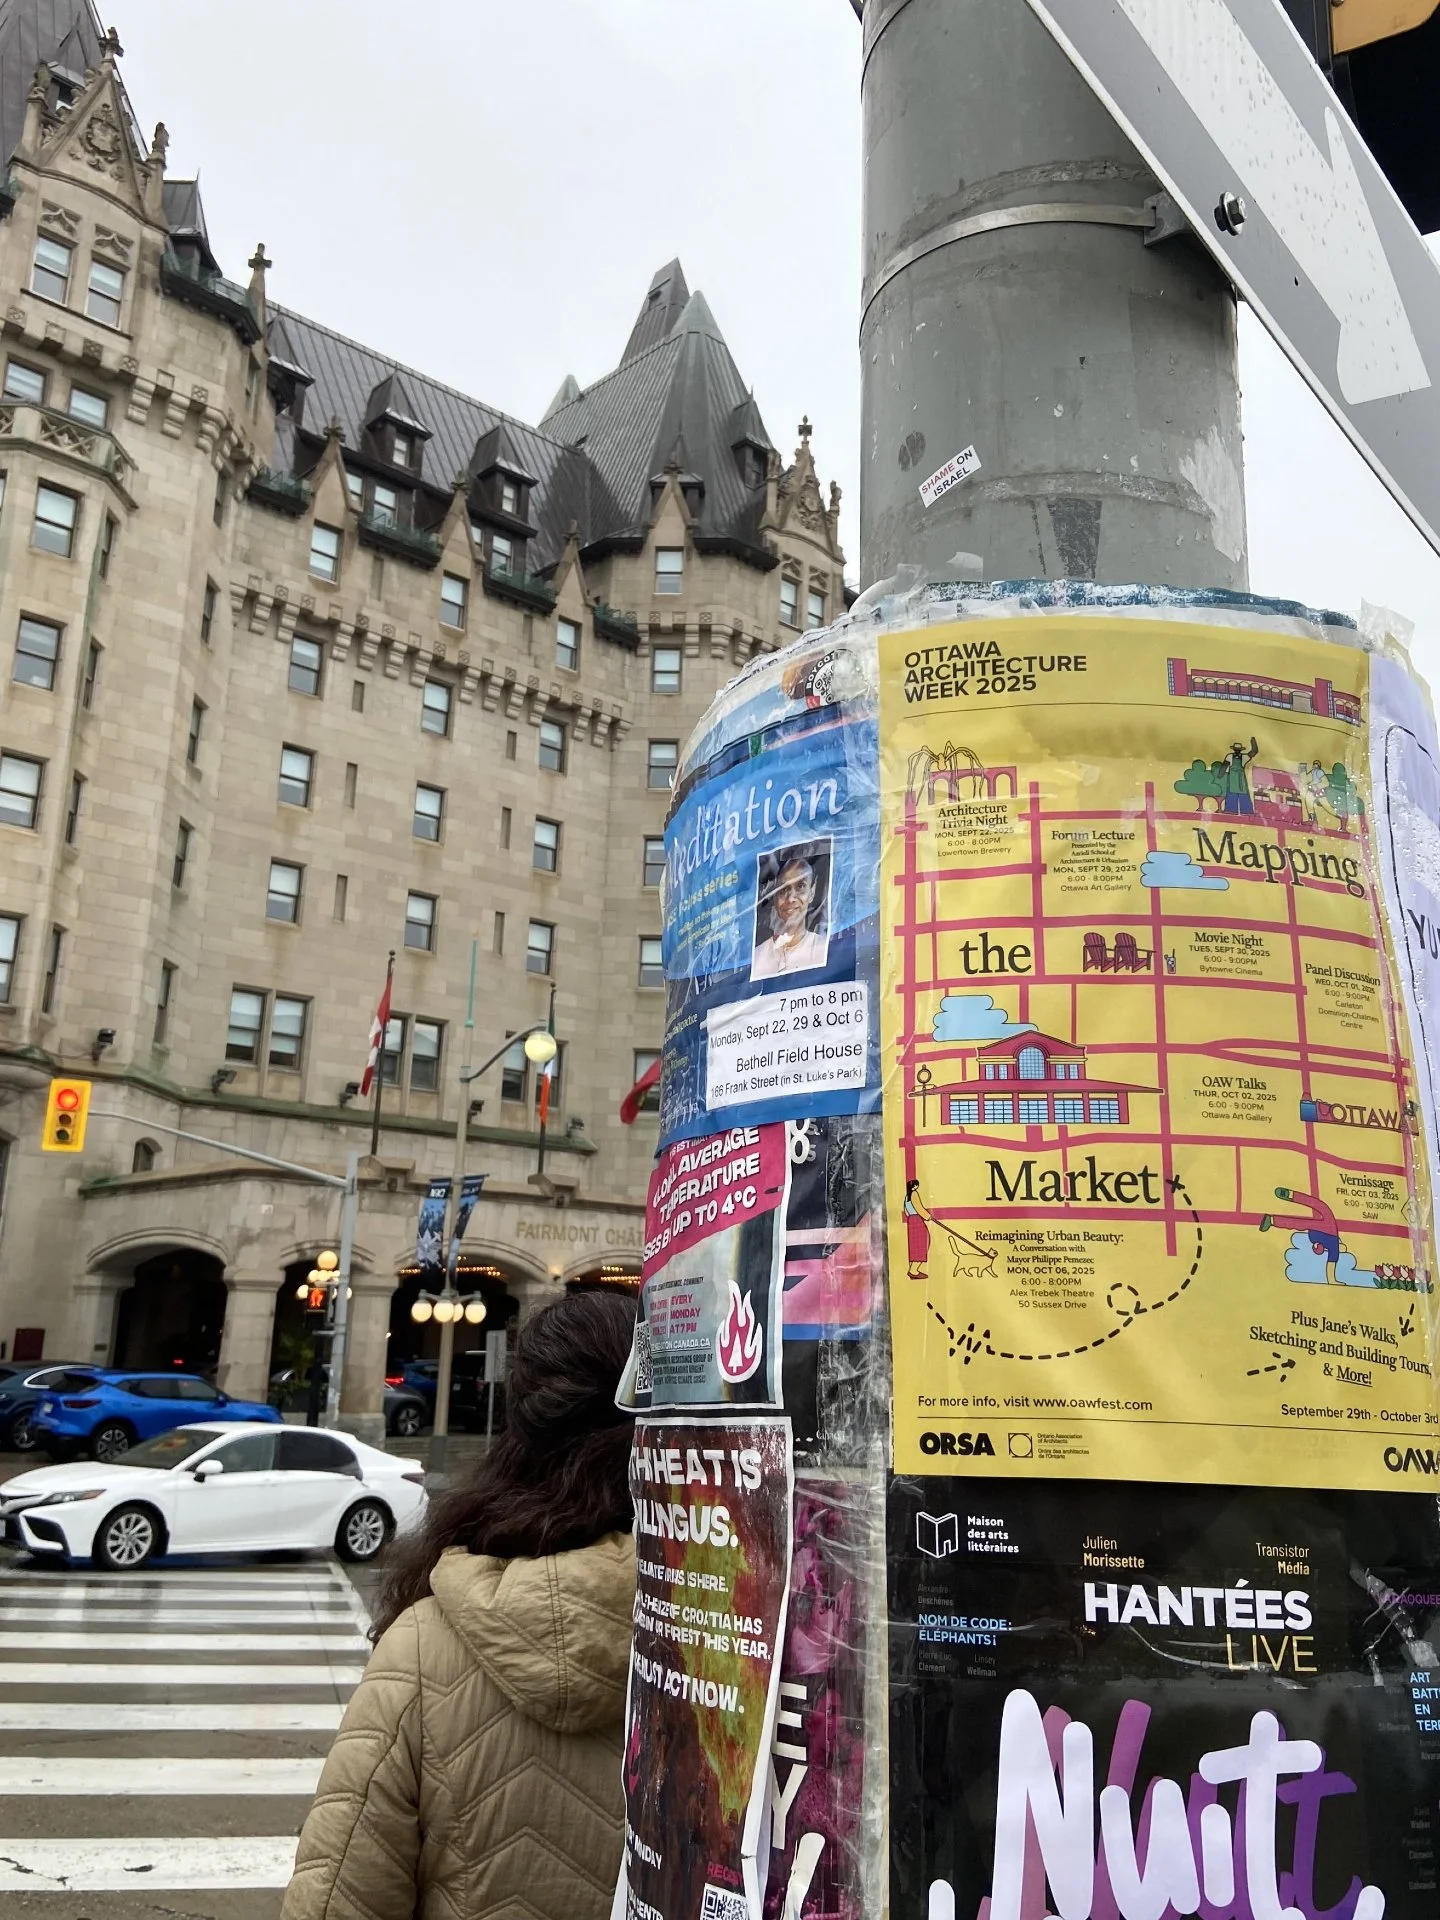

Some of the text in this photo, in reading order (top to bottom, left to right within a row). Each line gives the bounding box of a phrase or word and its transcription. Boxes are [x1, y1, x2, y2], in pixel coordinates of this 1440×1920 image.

[922, 450, 973, 494] SHAME ON
[933, 467, 970, 496] ISRAEL
[904, 641, 1002, 668] OTTAWA
[904, 656, 1087, 686] ARCHITECTURE
[904, 674, 1037, 703] WEEK 2025
[938, 804, 1007, 818] Architecture
[940, 814, 1008, 829] Trivia Night
[1051, 831, 1135, 841] Forum Lecture
[938, 847, 1012, 857] Lowertown Brewery
[1192, 827, 1366, 899] Mapping
[704, 870, 739, 897] series
[1104, 884, 1131, 892] Gallery
[1194, 932, 1264, 949] Movie Night
[1407, 909, 1440, 960] YU
[959, 931, 1032, 975] the
[1215, 945, 1271, 957] SEPT 2025
[1229, 956, 1257, 965] 9:00PM
[1199, 965, 1263, 976] Bytowne Cinema
[1305, 963, 1381, 986] Panel Discussion
[780, 990, 863, 1013] 7 pm to 8 pm
[1336, 1000, 1363, 1010] Carleton
[1318, 1008, 1380, 1023] Dominion-Chalmers
[710, 1009, 863, 1049] Monday, Sept 22, 29 & Oct 6
[1340, 1020, 1363, 1029] Centre
[736, 1043, 863, 1073] Bethell Field House
[725, 1081, 748, 1096] Frank
[750, 1074, 779, 1090] Street
[780, 1074, 790, 1087] (in
[807, 1069, 834, 1083] Luke's
[836, 1068, 862, 1080] Park)
[1202, 1076, 1267, 1090] OAW Talks
[1222, 1091, 1277, 1101] OCT 2025
[1234, 1102, 1264, 1110] 9:00PM
[1201, 1111, 1272, 1123] Ottawa Art Gallery
[678, 1127, 760, 1176] AVERAGE
[985, 1155, 1161, 1204] Market
[1339, 1174, 1395, 1193] Vernissage
[660, 1153, 760, 1225] TEPERATURE
[1352, 1189, 1399, 1201] OCT 2025
[672, 1186, 757, 1237] UP TO 4°C
[1365, 1201, 1395, 1210] 10:30PM
[1362, 1212, 1379, 1220] SAW
[516, 1222, 600, 1243] FAIRMONT
[975, 1230, 1124, 1245] Reimagining Urban Beauty:
[1007, 1256, 1062, 1265] Mayor Philippe
[1007, 1267, 1032, 1275] MON,
[1072, 1267, 1095, 1275] 2025
[1021, 1278, 1082, 1286] 6:00 8:00PM
[670, 1293, 693, 1306] EVERY
[1009, 1289, 1095, 1297] Alex Trebek Theatre
[1032, 1301, 1062, 1309] Sussex
[1064, 1301, 1087, 1309] Drive
[670, 1307, 701, 1320] MONDAY
[686, 1322, 697, 1333] PM
[1290, 1311, 1399, 1348] Plus Jane's Walks,
[1249, 1326, 1432, 1379] Sketching and Building Tours,
[1323, 1362, 1372, 1385] & More!
[918, 1396, 1153, 1411] For more info, visit www.oawfest.com
[1281, 1404, 1439, 1424] September 29th October 3rd
[919, 1432, 996, 1456] ORSA
[652, 1448, 725, 1486] HEAT
[731, 1449, 762, 1490] IS
[689, 1505, 739, 1548] US.
[967, 1515, 1004, 1527] Maison
[967, 1529, 1009, 1540] des arts
[967, 1541, 1019, 1554] littéraires
[1083, 1535, 1117, 1550] Julien
[1256, 1542, 1309, 1558] Transistor
[1083, 1553, 1145, 1569] Morissette
[1278, 1561, 1310, 1576] Média
[1084, 1578, 1313, 1630] HANTÉES
[682, 1606, 732, 1631] CROATIA
[733, 1614, 763, 1636] HAS
[919, 1613, 1012, 1631] NOM DE CODE:
[703, 1631, 772, 1661] THIS YEAR.
[1226, 1633, 1318, 1672] LIVE
[918, 1662, 946, 1674] Clement
[967, 1666, 997, 1677] Wellman
[1410, 1672, 1431, 1683] ART
[664, 1668, 745, 1714] ACT NOW.
[1412, 1687, 1440, 1699] BATT
[1414, 1703, 1431, 1715] EN
[991, 1688, 1385, 1920] Nuit
